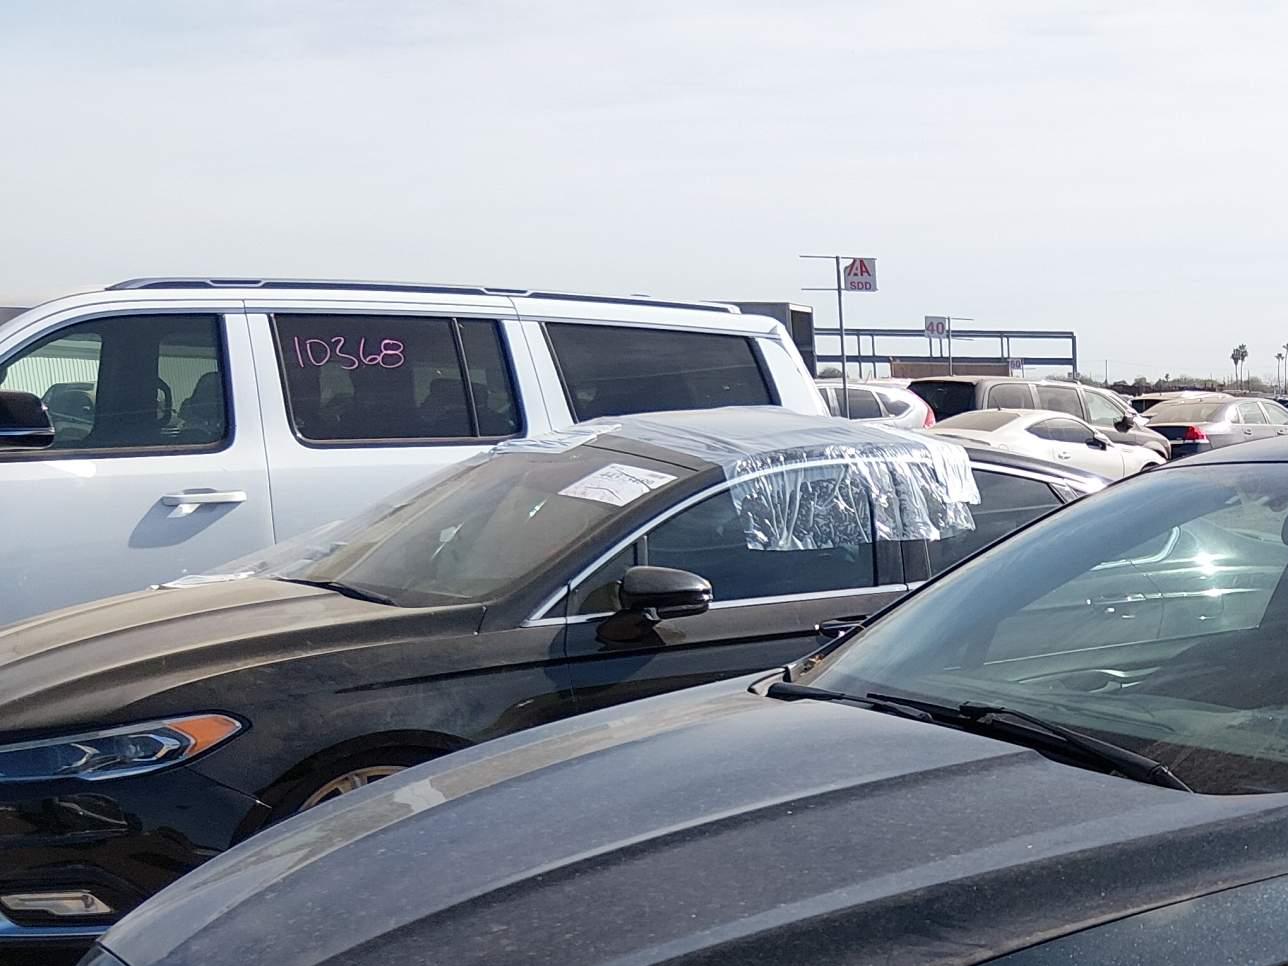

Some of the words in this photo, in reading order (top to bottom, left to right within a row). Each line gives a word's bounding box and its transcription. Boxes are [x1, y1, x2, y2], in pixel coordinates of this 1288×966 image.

[850, 281, 872, 291] SDD
[927, 321, 945, 334] 40
[294, 336, 405, 370] 10368
